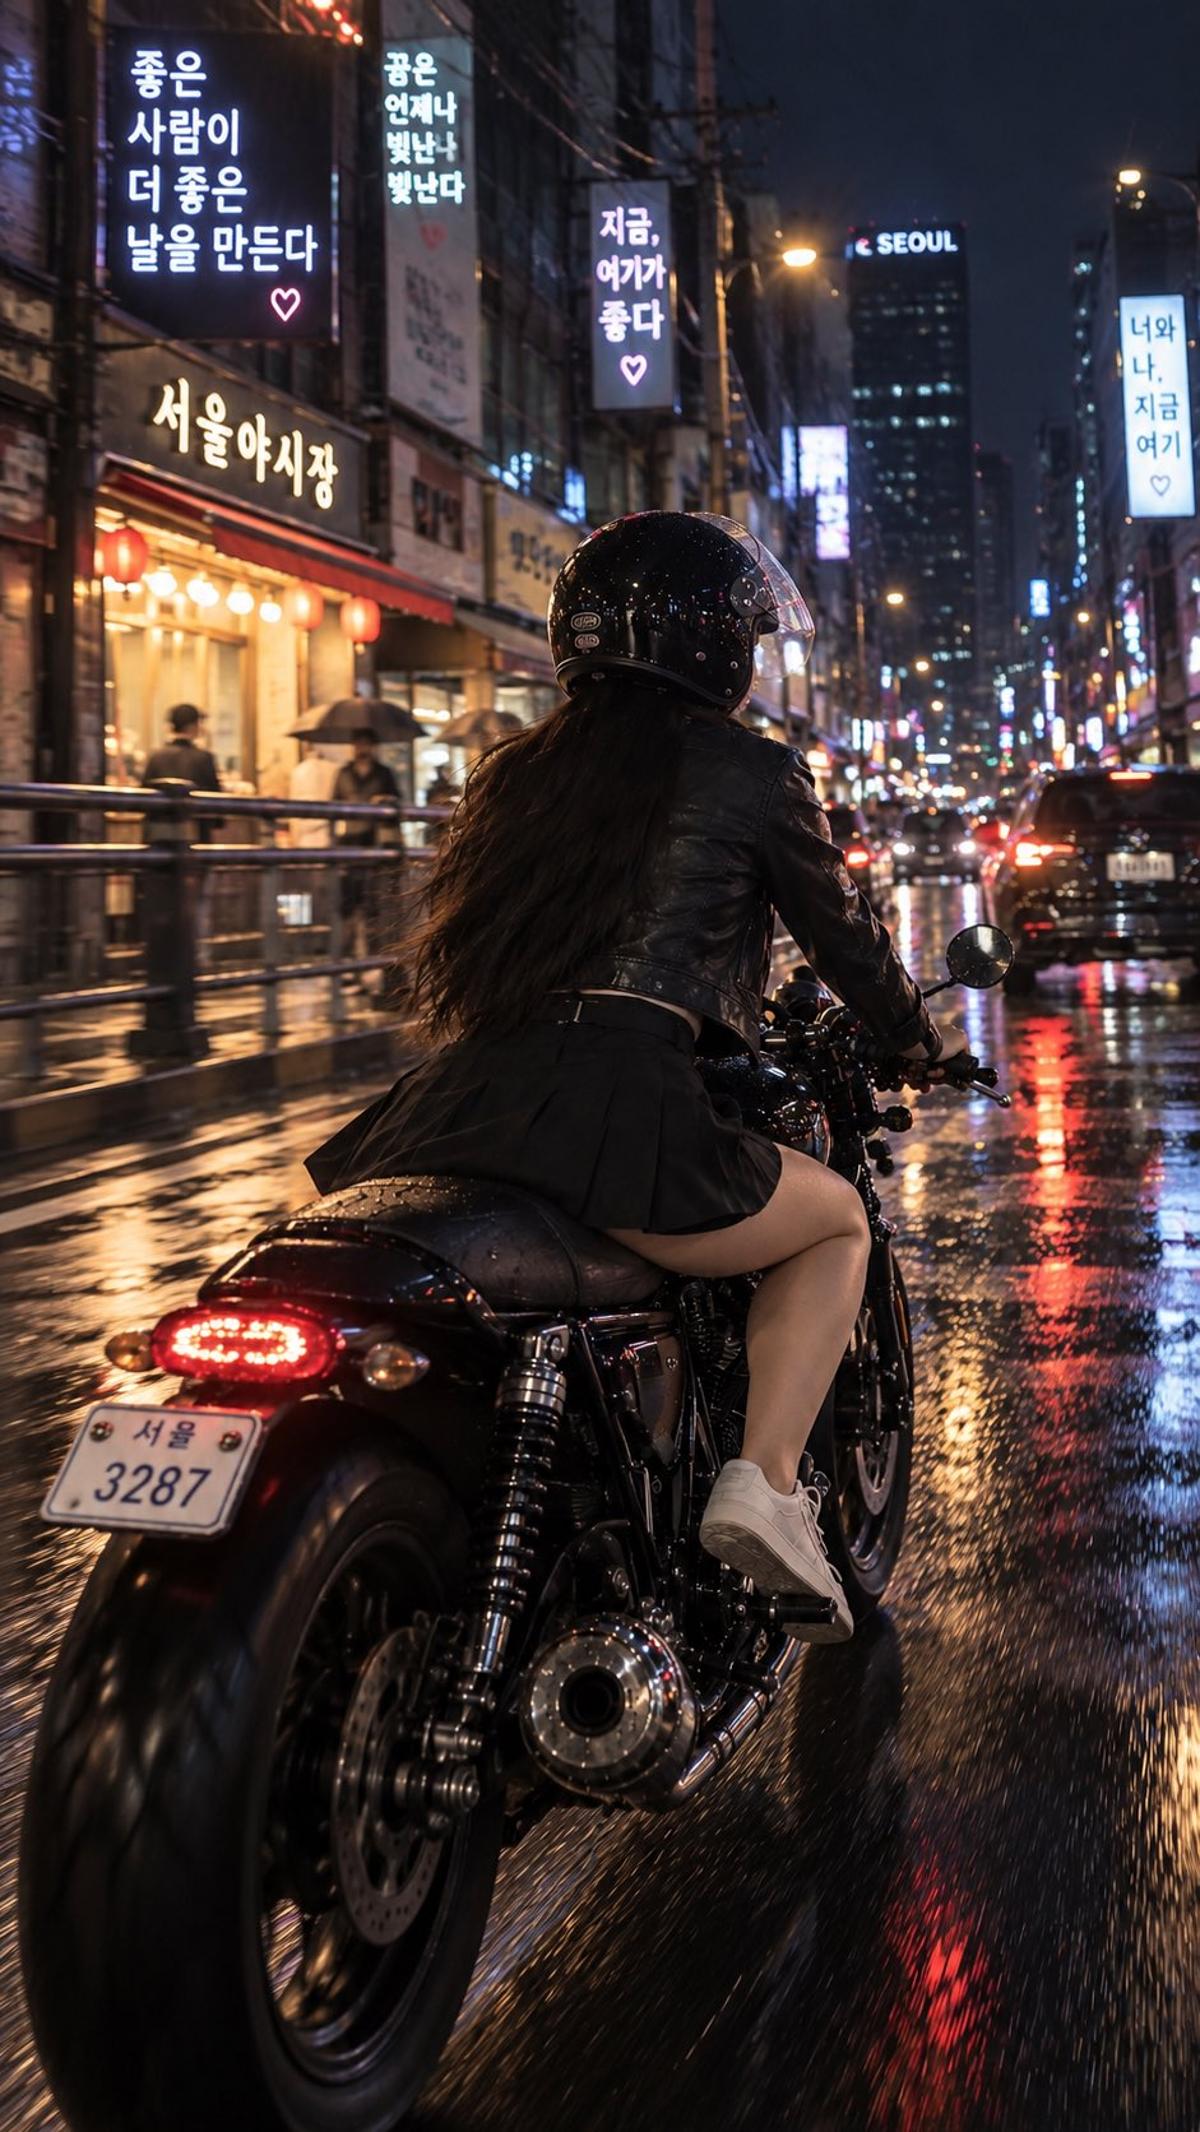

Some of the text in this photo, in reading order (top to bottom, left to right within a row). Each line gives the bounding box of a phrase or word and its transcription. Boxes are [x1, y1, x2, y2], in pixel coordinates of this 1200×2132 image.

[130, 50, 207, 99] 좋은
[384, 91, 458, 126] 언제나
[127, 107, 240, 157] 사람이
[128, 164, 248, 215] 더 좋은
[387, 170, 466, 205] 빛난다
[599, 206, 660, 247] 지금,
[876, 230, 959, 255] SEOUL
[127, 223, 319, 273] 날을 만든다
[596, 253, 667, 292] 여기가
[598, 298, 665, 343] 좋다
[1130, 314, 1176, 342] 너와
[1134, 392, 1179, 421] 지금
[152, 377, 340, 510] 서울야시장
[1137, 430, 1181, 459] 여기
[133, 1420, 197, 1450] 서울
[94, 1461, 212, 1508] 3287
